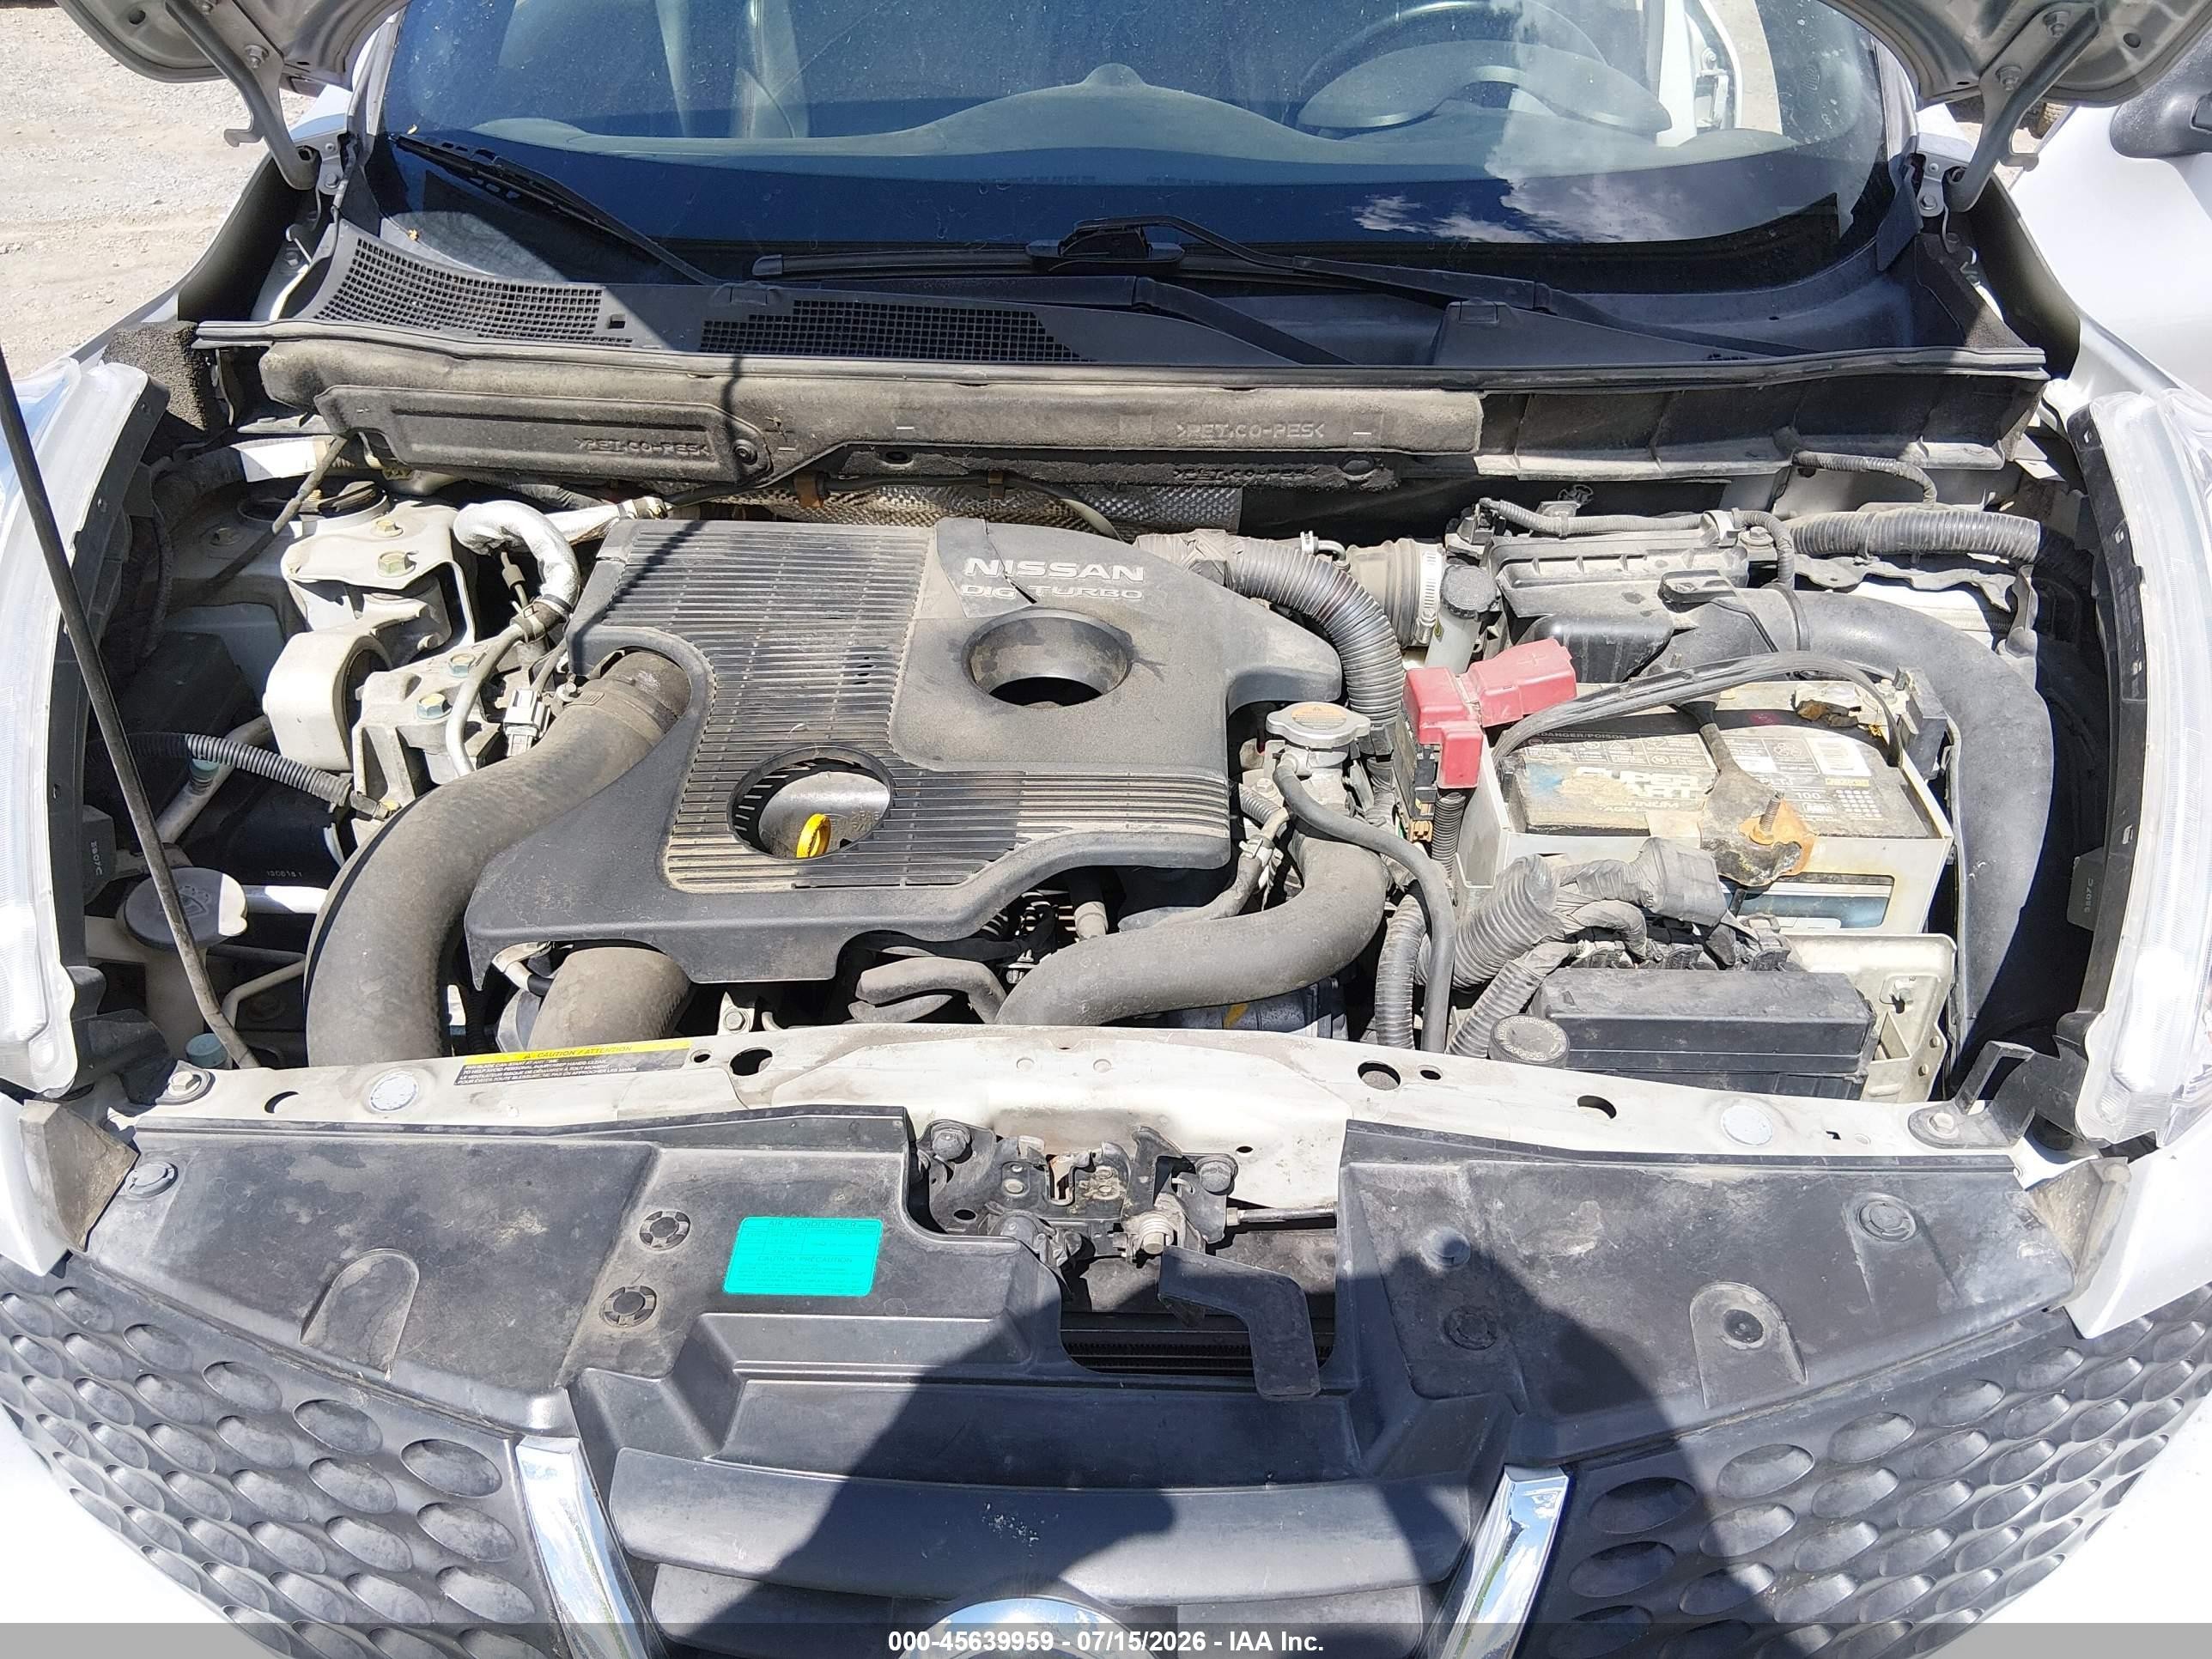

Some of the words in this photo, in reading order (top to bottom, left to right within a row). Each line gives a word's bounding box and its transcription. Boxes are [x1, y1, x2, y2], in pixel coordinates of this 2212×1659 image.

[963, 558, 1145, 581] NISSAN
[961, 584, 1017, 599] DIG
[1028, 585, 1145, 599] TURBO
[585, 1046, 633, 1054] ATTENTION
[789, 1219, 857, 1228] CONDITIONER
